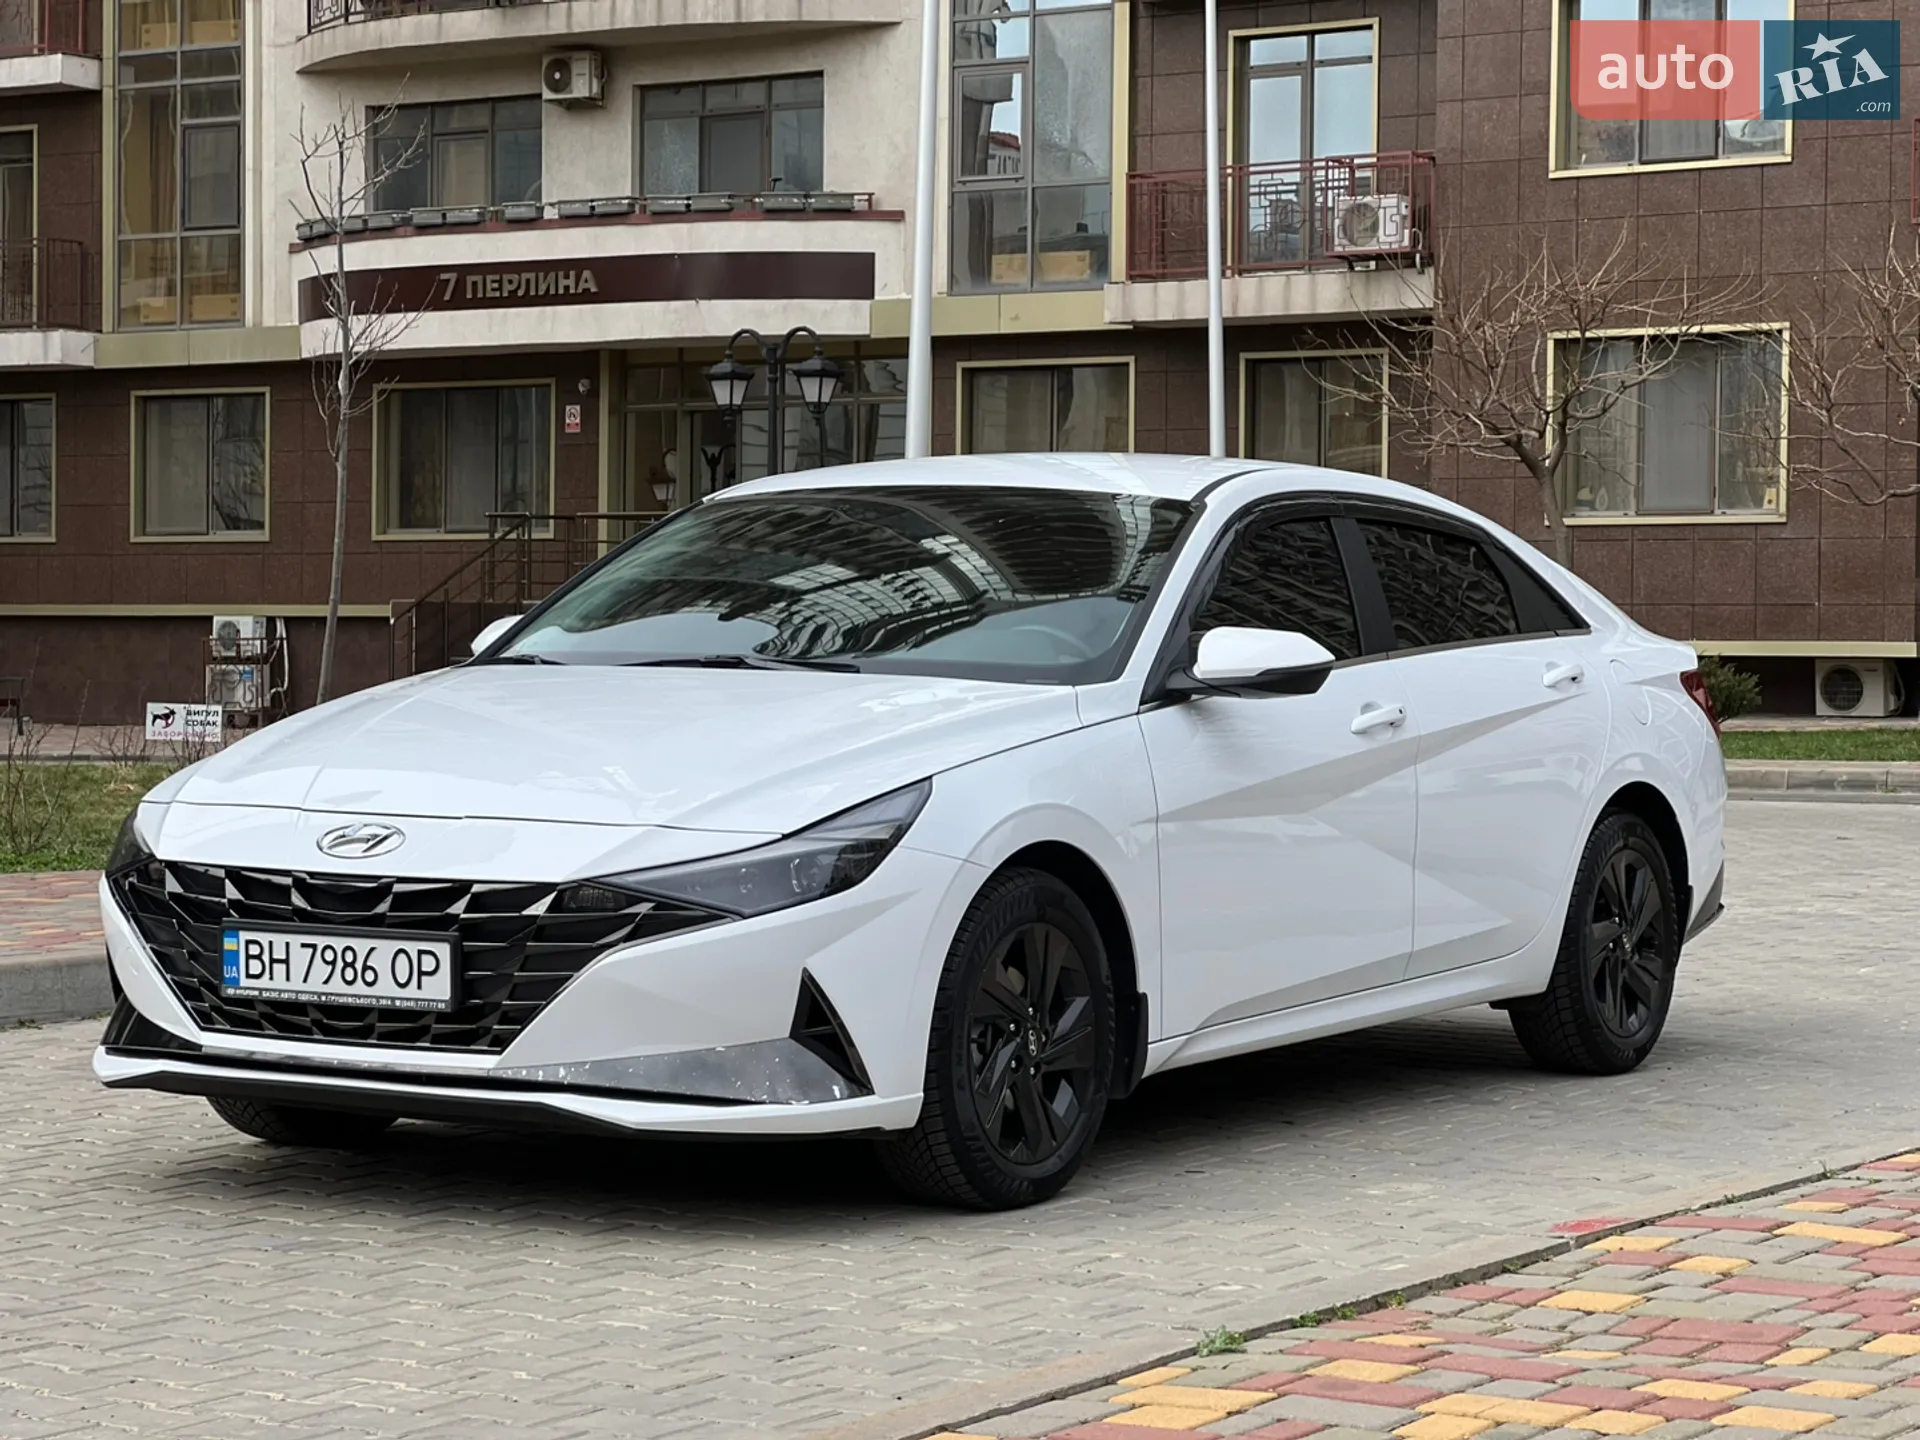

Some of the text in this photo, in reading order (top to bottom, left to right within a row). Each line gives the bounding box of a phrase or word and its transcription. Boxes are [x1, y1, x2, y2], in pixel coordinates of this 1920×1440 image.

[439, 269, 599, 301] 7 ПЕРЛИНА
[186, 709, 219, 717] ВИГУЛ
[185, 719, 219, 727] СОБАК
[244, 939, 441, 991] BH 7986 OP
[223, 966, 239, 979] UA
